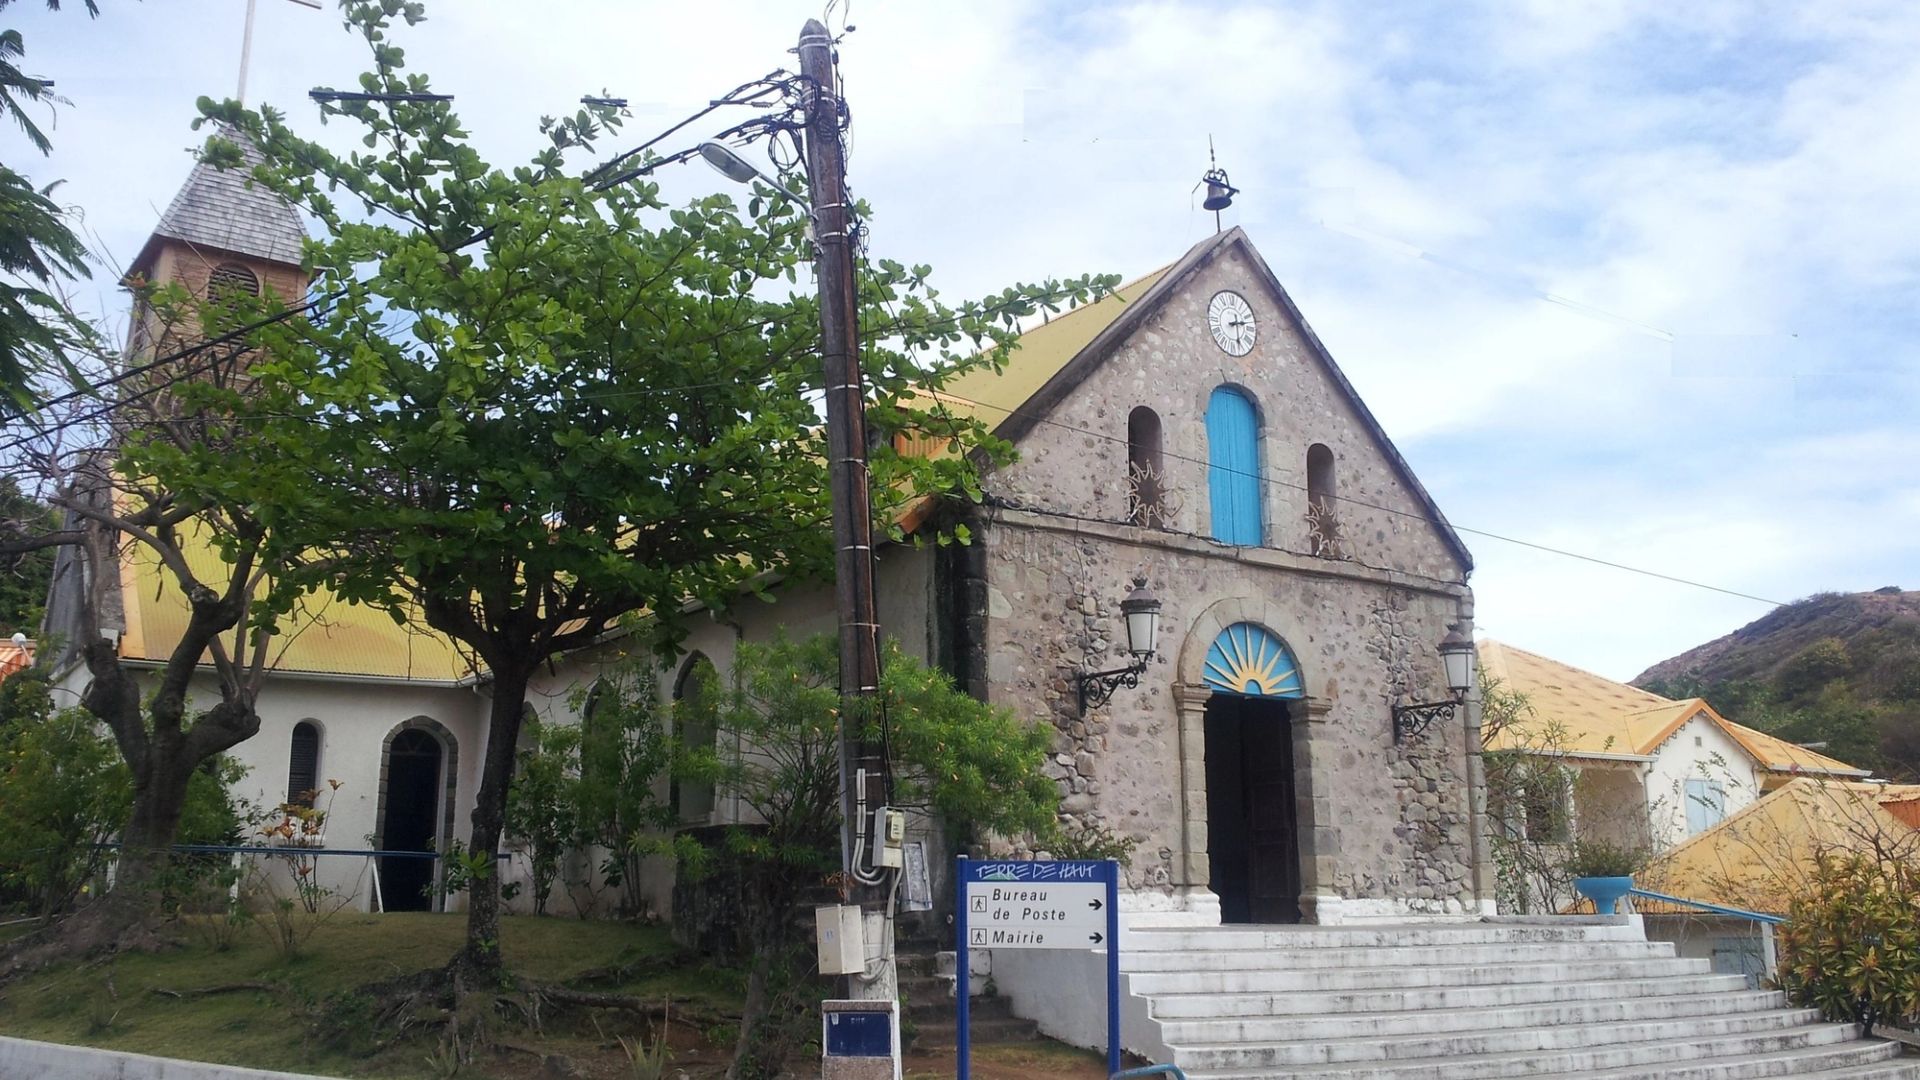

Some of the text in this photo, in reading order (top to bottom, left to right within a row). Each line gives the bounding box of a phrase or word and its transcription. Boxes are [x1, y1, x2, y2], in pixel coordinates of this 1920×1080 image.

[976, 863, 1096, 880] TERRE DE HAUT
[992, 888, 1047, 901] Bureau
[993, 907, 1066, 920] de Poste
[992, 930, 1044, 944] Mairie
